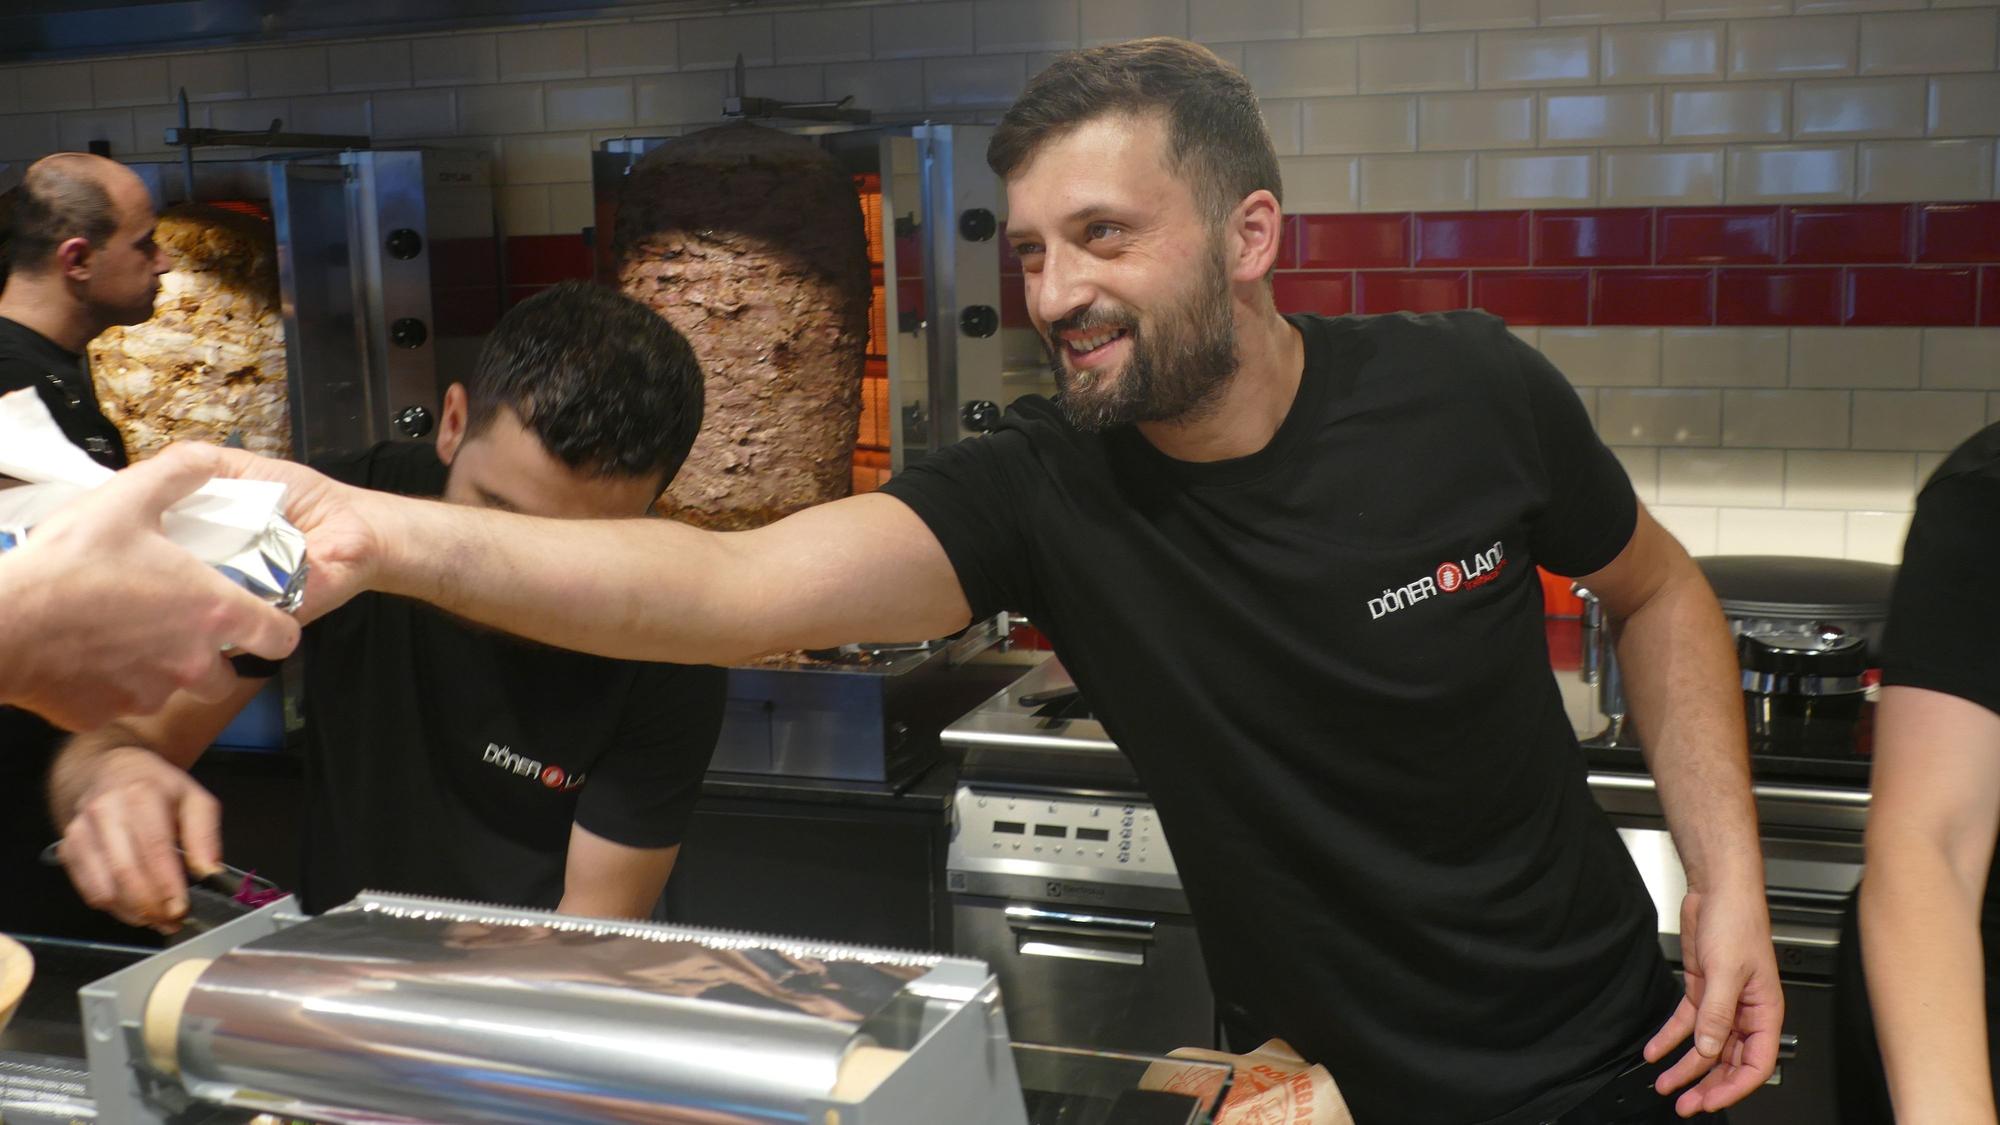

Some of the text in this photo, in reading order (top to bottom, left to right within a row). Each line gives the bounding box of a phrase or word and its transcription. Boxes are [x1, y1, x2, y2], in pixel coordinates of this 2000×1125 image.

[1367, 576, 1438, 620] DÖNER
[1460, 541, 1504, 580] LAND
[482, 742, 542, 780] DÖNER
